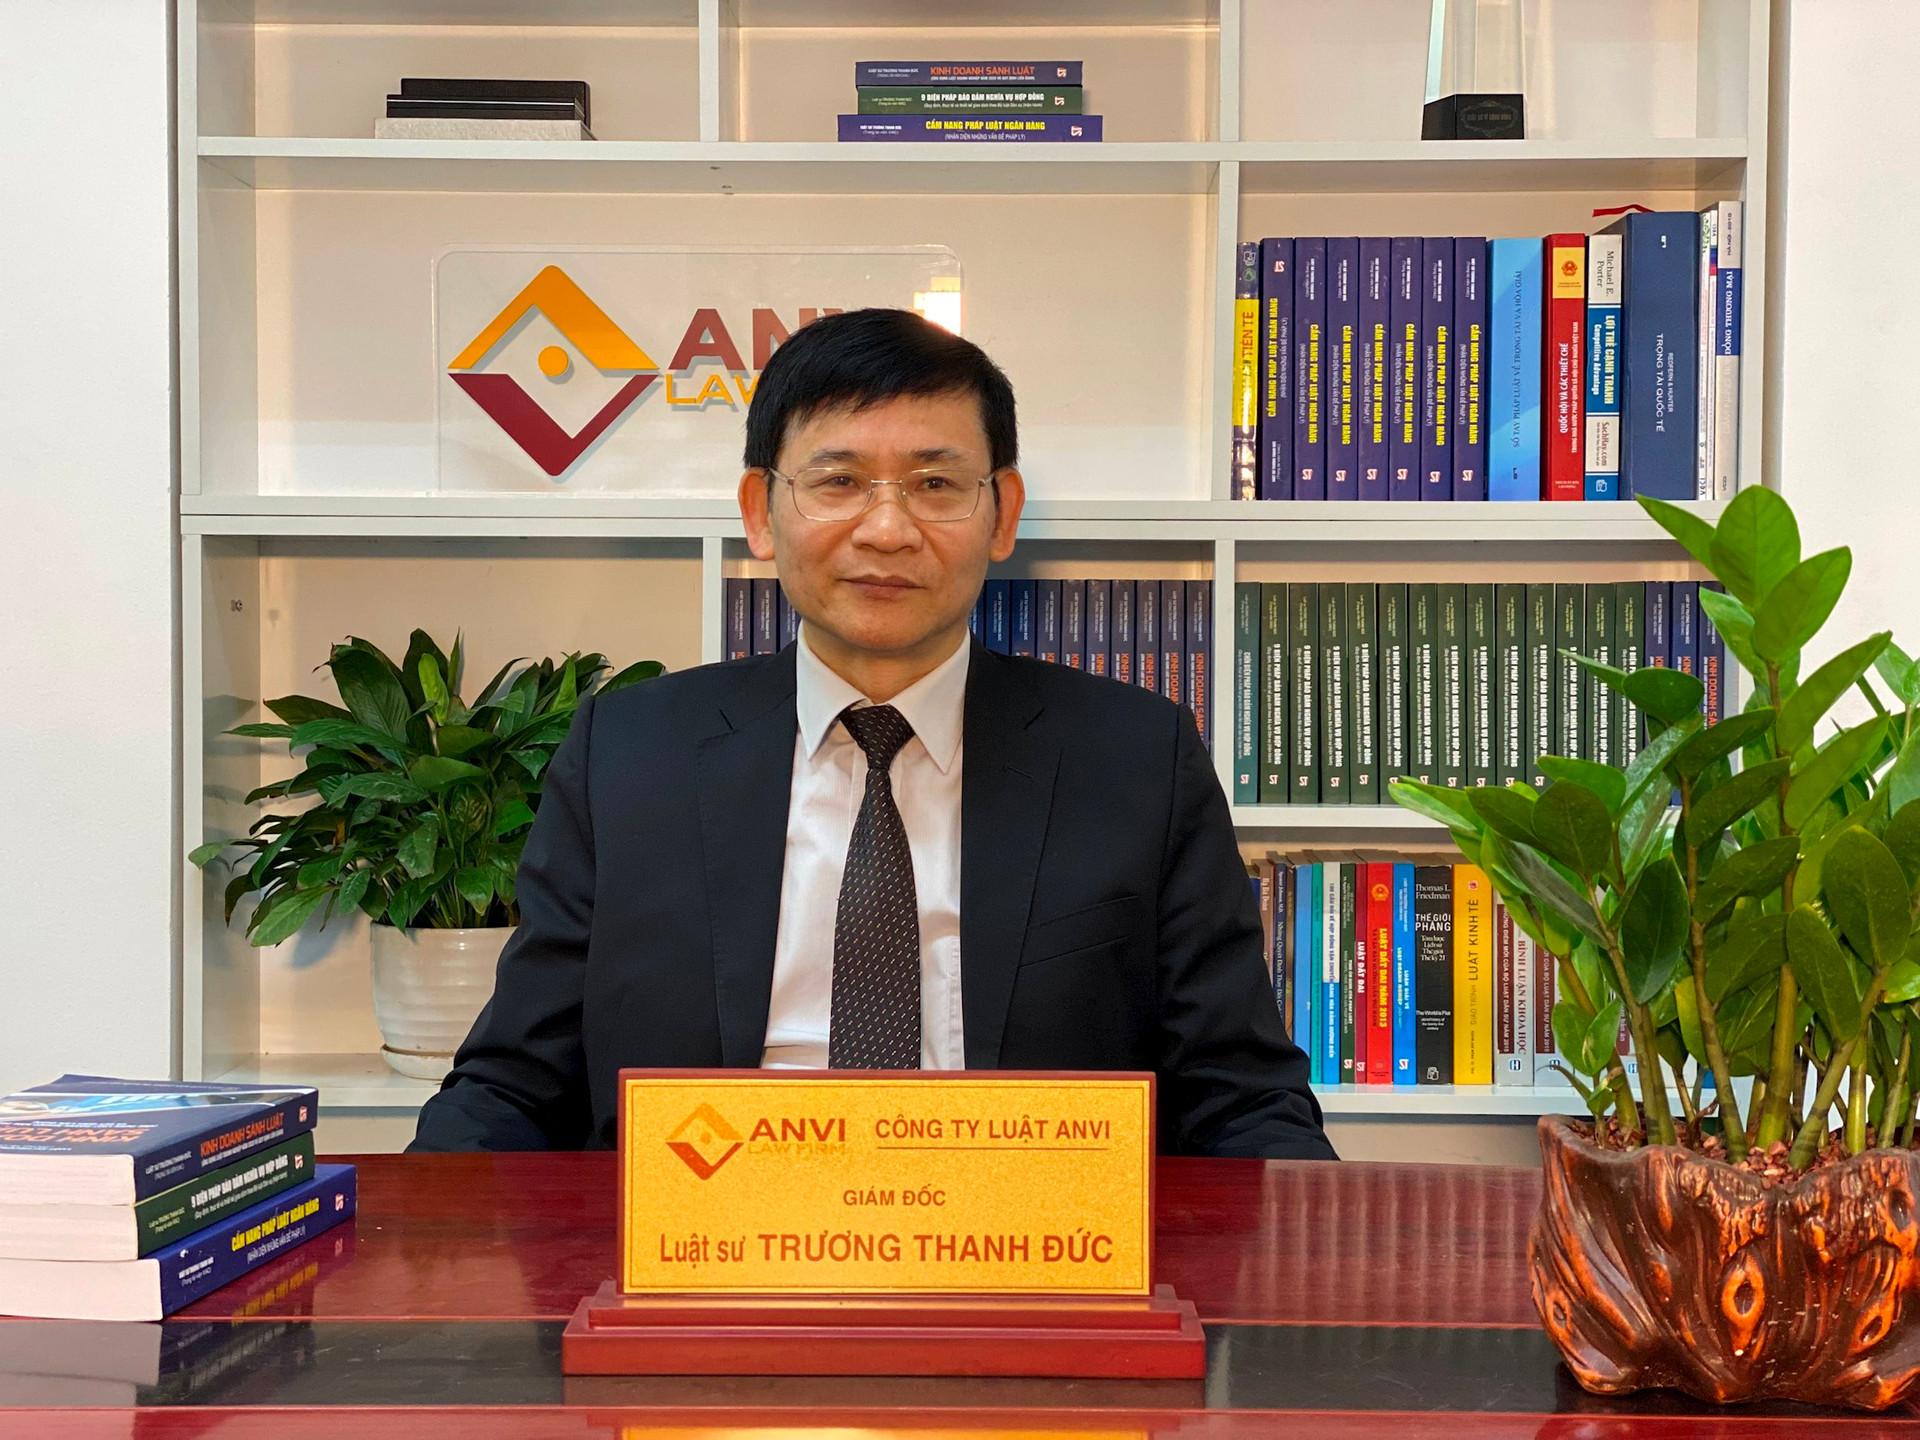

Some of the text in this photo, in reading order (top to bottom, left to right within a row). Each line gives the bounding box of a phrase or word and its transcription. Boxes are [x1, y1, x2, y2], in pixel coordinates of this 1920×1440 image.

[931, 67, 951, 75] KINH
[953, 67, 983, 75] DOANH
[944, 121, 963, 130] NANG
[965, 121, 984, 130] PHÁP
[986, 121, 1003, 131] LUẬT
[1005, 121, 1023, 130] NGÂN
[1024, 121, 1045, 130] HÀNG
[1596, 260, 1605, 288] Porter
[1605, 250, 1614, 296] Michael E.
[1726, 272, 1734, 288] MẠI
[1270, 298, 1278, 317] HÀNG
[1269, 320, 1278, 339] NGÂN
[1269, 340, 1277, 357] LUẬT
[1375, 342, 1384, 361] NANG
[1471, 343, 1480, 362] NANG
[1268, 359, 1277, 378] PHÁP
[1592, 324, 1602, 395] Competitive Advantage
[1604, 349, 1615, 372] CẠNH
[1374, 363, 1384, 381] PHÁP
[1470, 364, 1480, 382] PHÁP
[1268, 380, 1276, 399] NANG
[1374, 383, 1383, 400] LUẬT
[1470, 385, 1479, 400] LUẬT
[1604, 375, 1614, 404] TRANH
[1656, 334, 1665, 432] TRỌNG TÀI QUỐC TẾ
[1373, 402, 1383, 421] NGÂN
[1469, 404, 1479, 422] NGÂN
[1511, 399, 1520, 419] PHÁP
[1373, 423, 1382, 443] HÀNG
[1469, 424, 1478, 444] HÀNG
[1511, 421, 1520, 435] TAY
[1196, 653, 1204, 672] KINH
[1196, 674, 1204, 705] DOANH
[1416, 884, 1444, 892] Thomas
[1416, 892, 1450, 900] Friedman
[1379, 928, 1388, 949] LUẬT
[1468, 916, 1478, 945] KINH
[1356, 942, 1366, 992] LUẬT ĐẤT ĐAI
[1379, 951, 1388, 967] ĐẤT
[1379, 969, 1388, 983] ĐAI
[1517, 941, 1528, 1054] BÌNH LUẬN KHOA HỌC
[1379, 1007, 1388, 1027] 2013
[749, 1118, 846, 1141] ANVI
[875, 1114, 1110, 1144] CÔNG TY LUẬT ANVI
[201, 1139, 218, 1157] KINH
[843, 1183, 946, 1206] GIÁM ĐỐC
[660, 1228, 1112, 1269] Luật sư TRƯƠNG THANH ĐỨC
